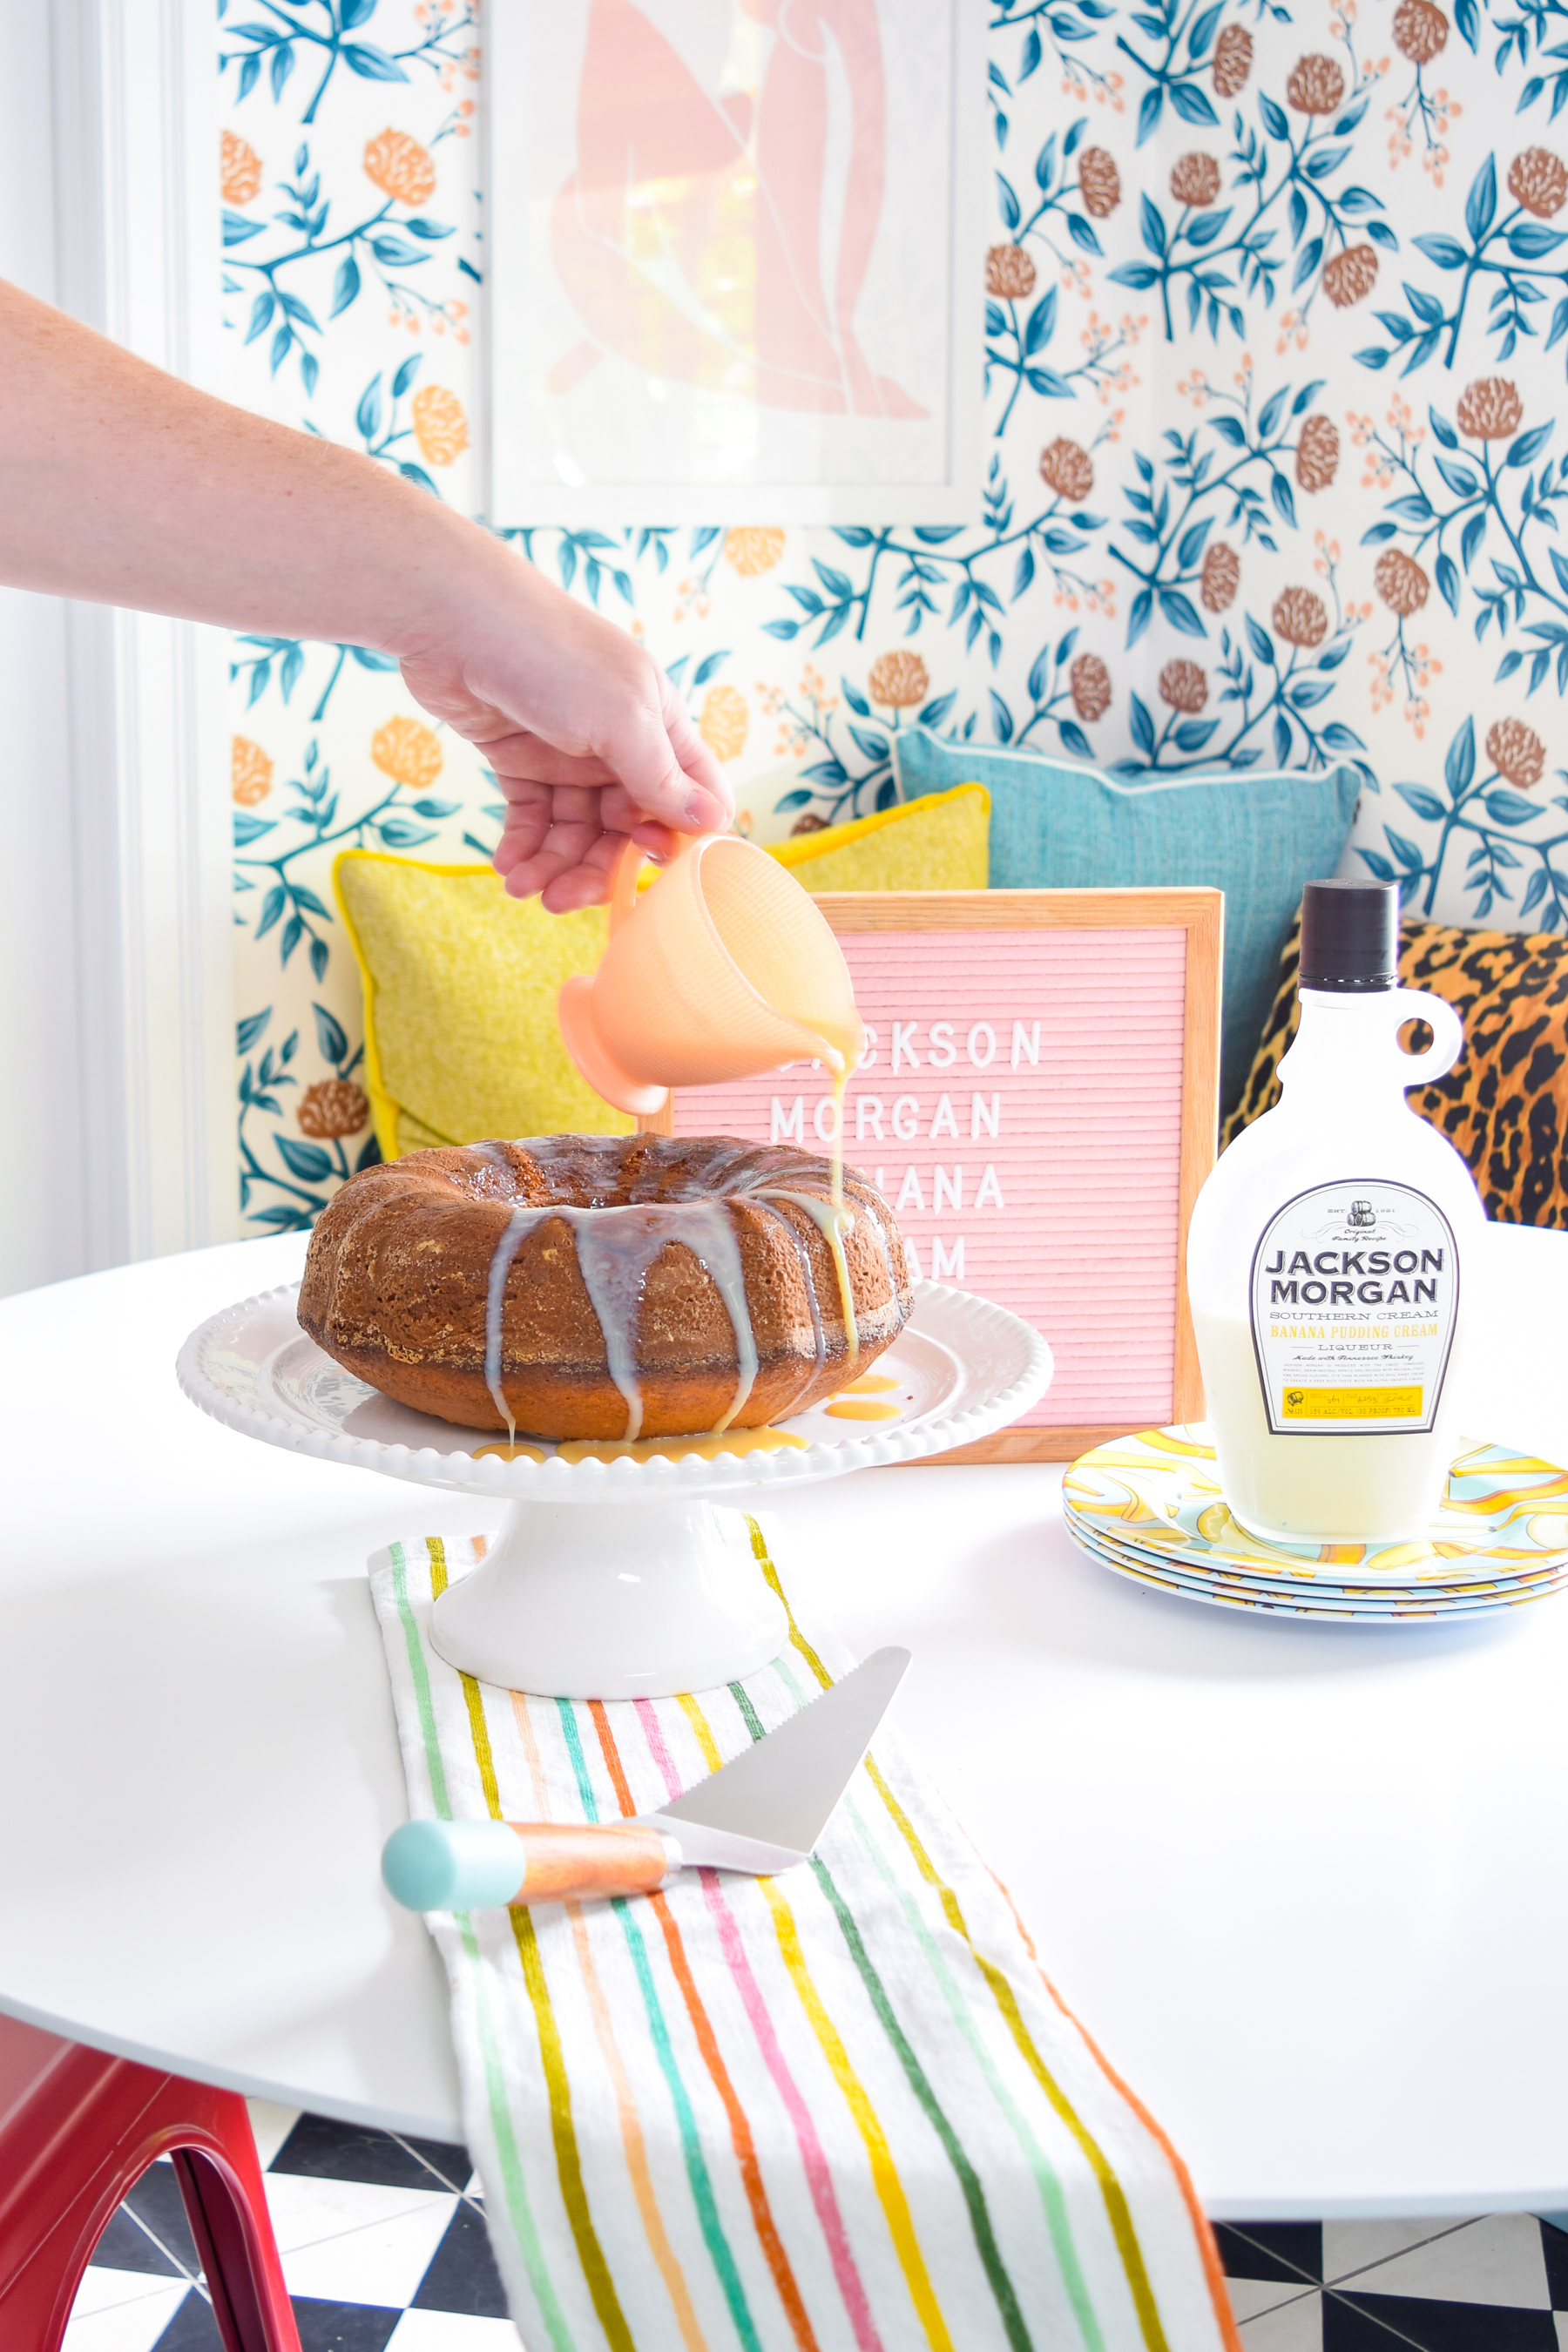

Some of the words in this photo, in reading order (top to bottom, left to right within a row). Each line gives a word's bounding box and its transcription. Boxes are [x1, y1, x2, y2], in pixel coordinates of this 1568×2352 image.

[769, 1092, 1001, 1143] MORGAN
[1265, 1248, 1444, 1276] JACKSON
[1269, 1278, 1438, 1306] MORGAN
[1269, 1311, 1371, 1321] SOUTHERN
[1376, 1310, 1439, 1320] CREAM
[1270, 1325, 1326, 1339] BANANA
[1331, 1325, 1389, 1339] PUDDING
[1394, 1323, 1438, 1338] CREAM
[1358, 1396, 1376, 1404] 6253
